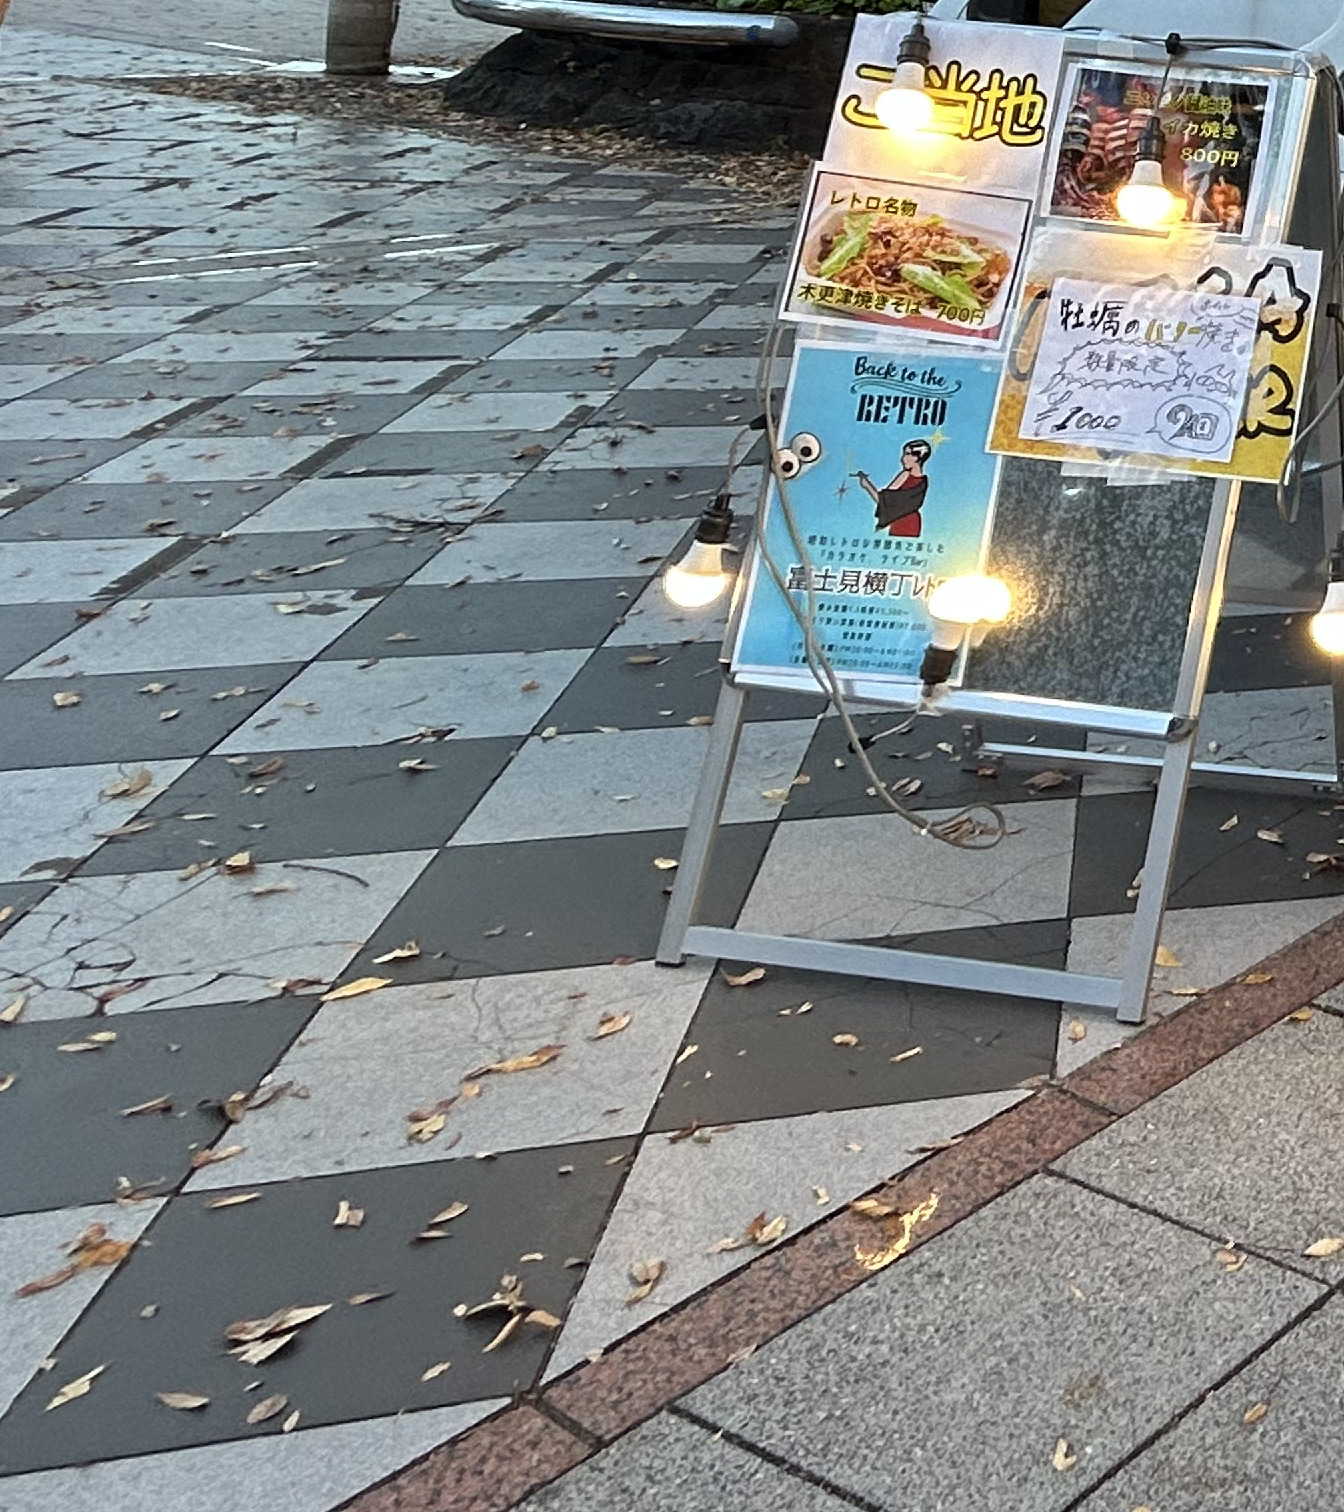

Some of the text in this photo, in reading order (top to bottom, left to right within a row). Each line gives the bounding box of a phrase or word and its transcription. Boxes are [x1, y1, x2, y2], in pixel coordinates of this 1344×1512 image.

[1180, 147, 1240, 168] 800円
[830, 190, 919, 217] レトロ名物
[936, 303, 987, 326] 700円
[853, 355, 948, 389] Back to the
[856, 393, 949, 427] RETRO
